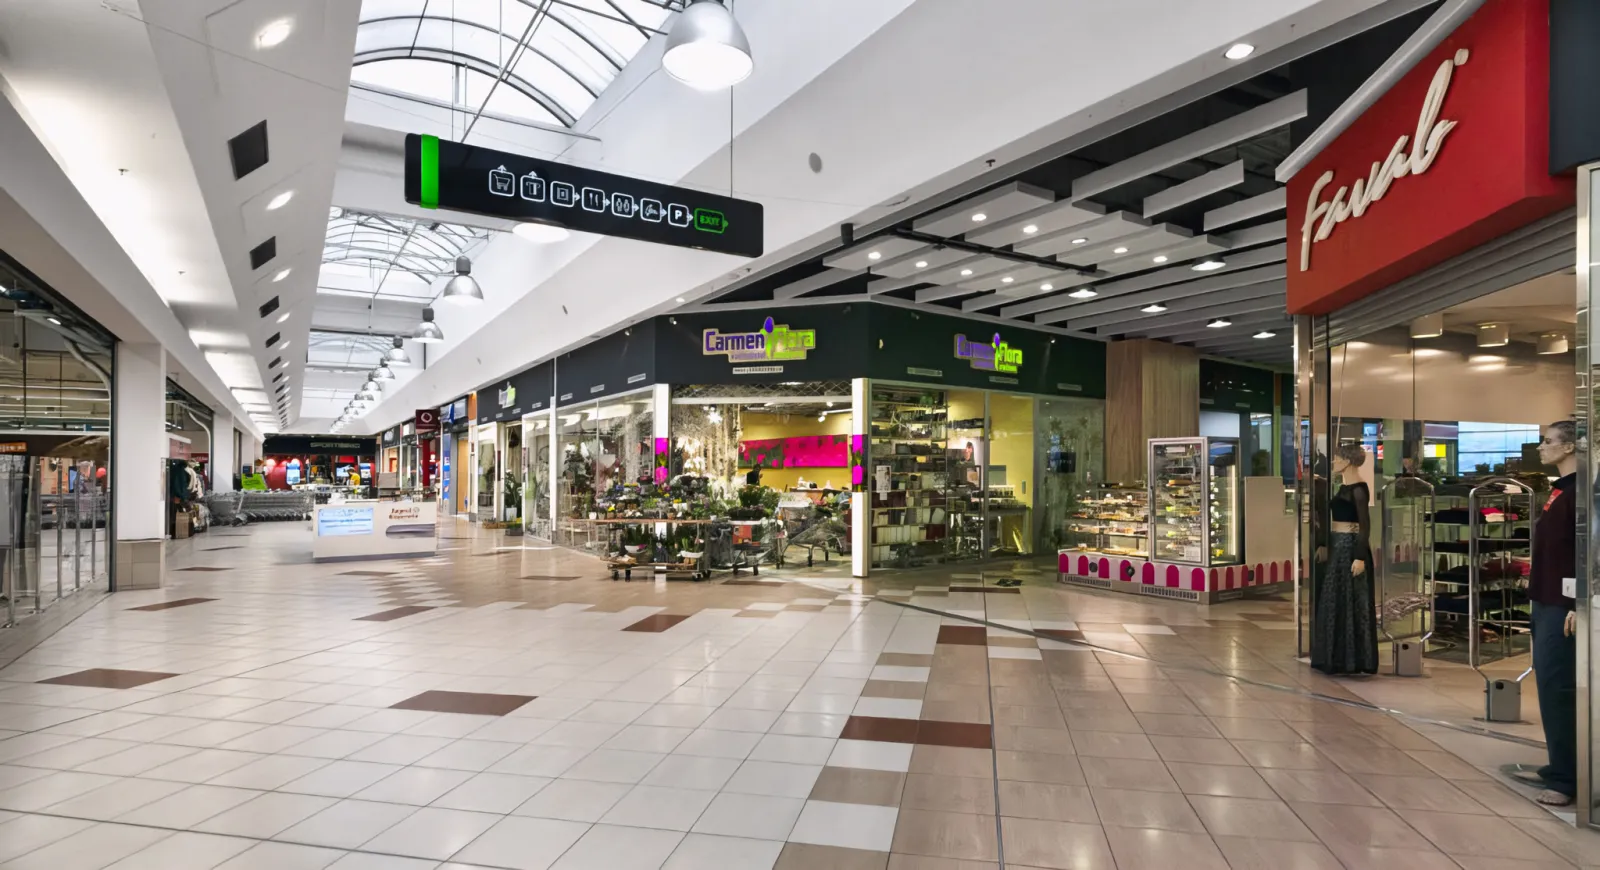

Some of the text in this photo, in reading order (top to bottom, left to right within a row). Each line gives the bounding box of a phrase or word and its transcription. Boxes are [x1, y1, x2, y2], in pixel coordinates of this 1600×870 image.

[674, 209, 683, 220] P
[700, 215, 720, 226] EXIT
[705, 331, 765, 351] Carmen
